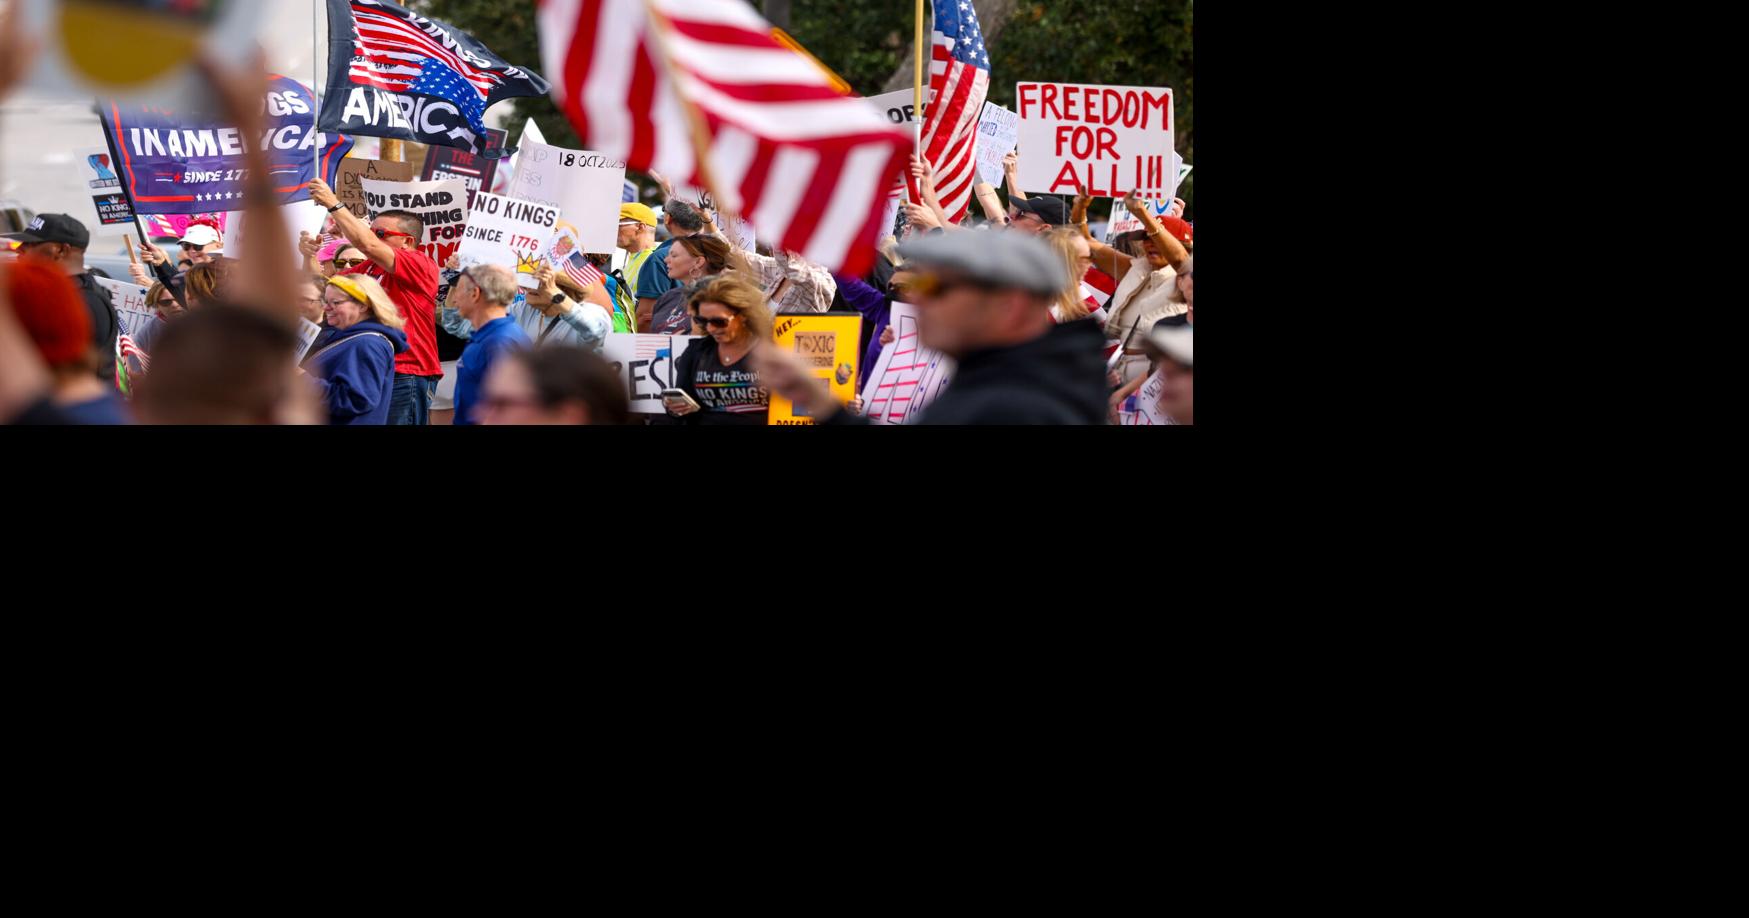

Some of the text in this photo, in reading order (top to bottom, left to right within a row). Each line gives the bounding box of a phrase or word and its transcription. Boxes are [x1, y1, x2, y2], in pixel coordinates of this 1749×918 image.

[404, 11, 492, 68] KINGS
[1018, 83, 1169, 131] FREEDOM
[130, 124, 328, 158] IN AMEICA
[1055, 125, 1121, 160] FOR
[451, 149, 476, 166] THE
[558, 151, 576, 167] 18
[366, 159, 378, 174] A
[183, 170, 222, 184] SINCE
[342, 190, 355, 199] IS
[390, 191, 454, 209] STAND
[99, 202, 131, 213] NO KING
[474, 194, 500, 215] NO
[503, 200, 556, 228] KINGS
[466, 225, 539, 251] SINCE 1776
[696, 370, 760, 383] We the Peopl
[696, 386, 768, 400] NO KINGS
